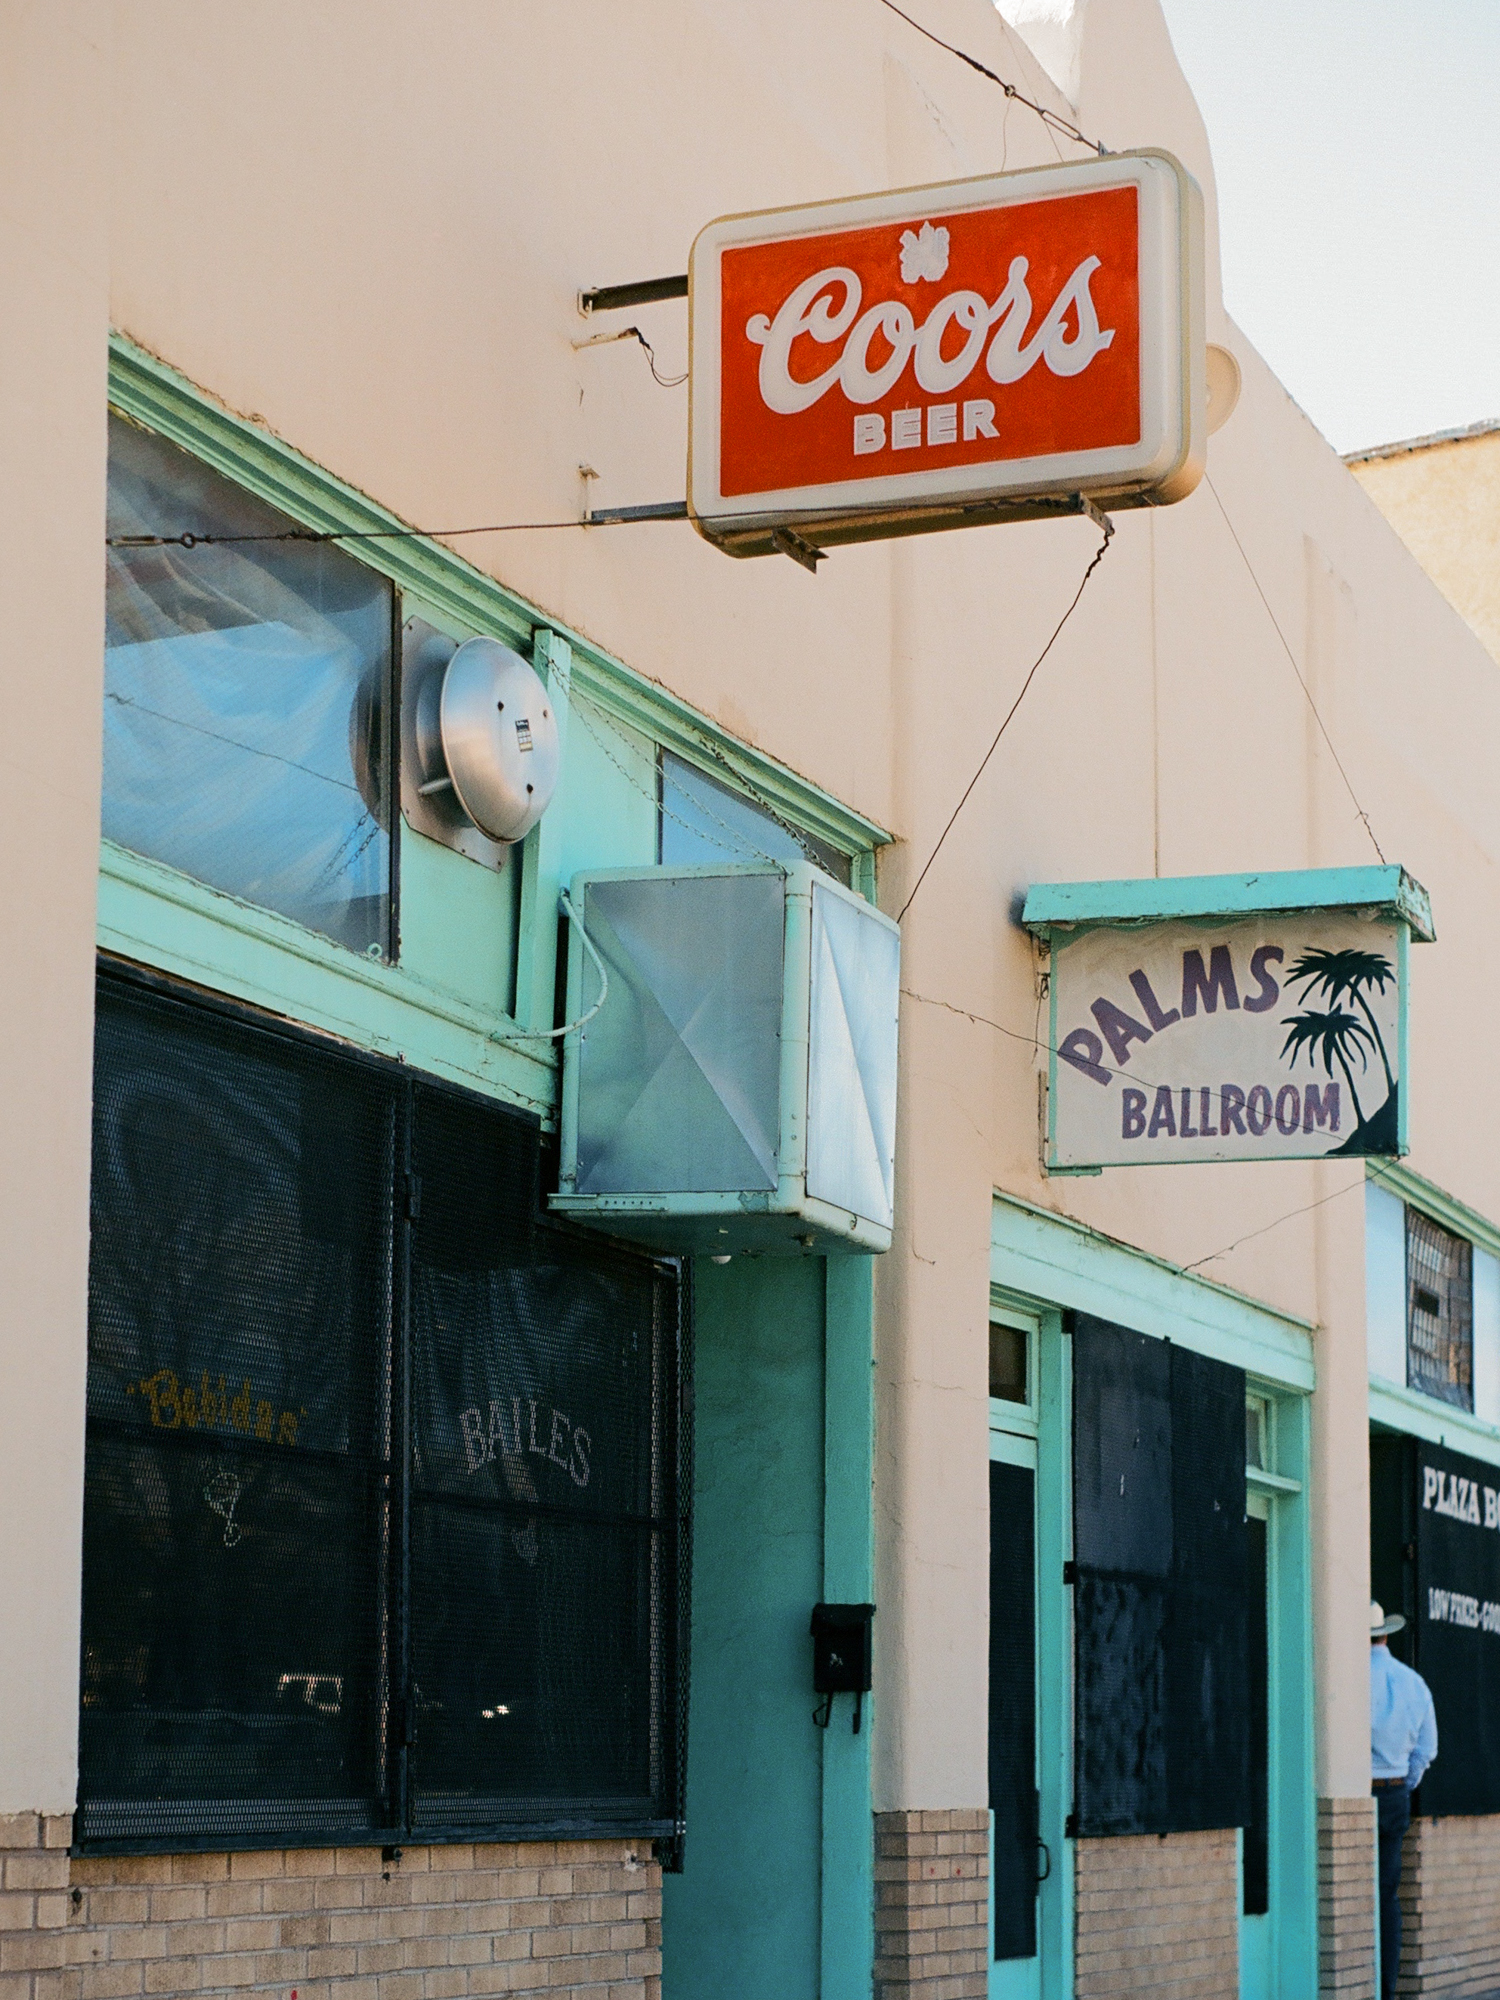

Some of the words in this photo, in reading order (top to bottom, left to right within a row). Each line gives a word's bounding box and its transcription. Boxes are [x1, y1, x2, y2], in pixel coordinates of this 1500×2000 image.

[745, 255, 1116, 415] Coors
[853, 399, 1000, 456] BEER
[1056, 944, 1285, 1087] PALMS
[1121, 1082, 1341, 1140] BALLROOM
[459, 1397, 592, 1487] BAILES
[1423, 1466, 1481, 1526] PLAZA
[1483, 1486, 1500, 1533] B
